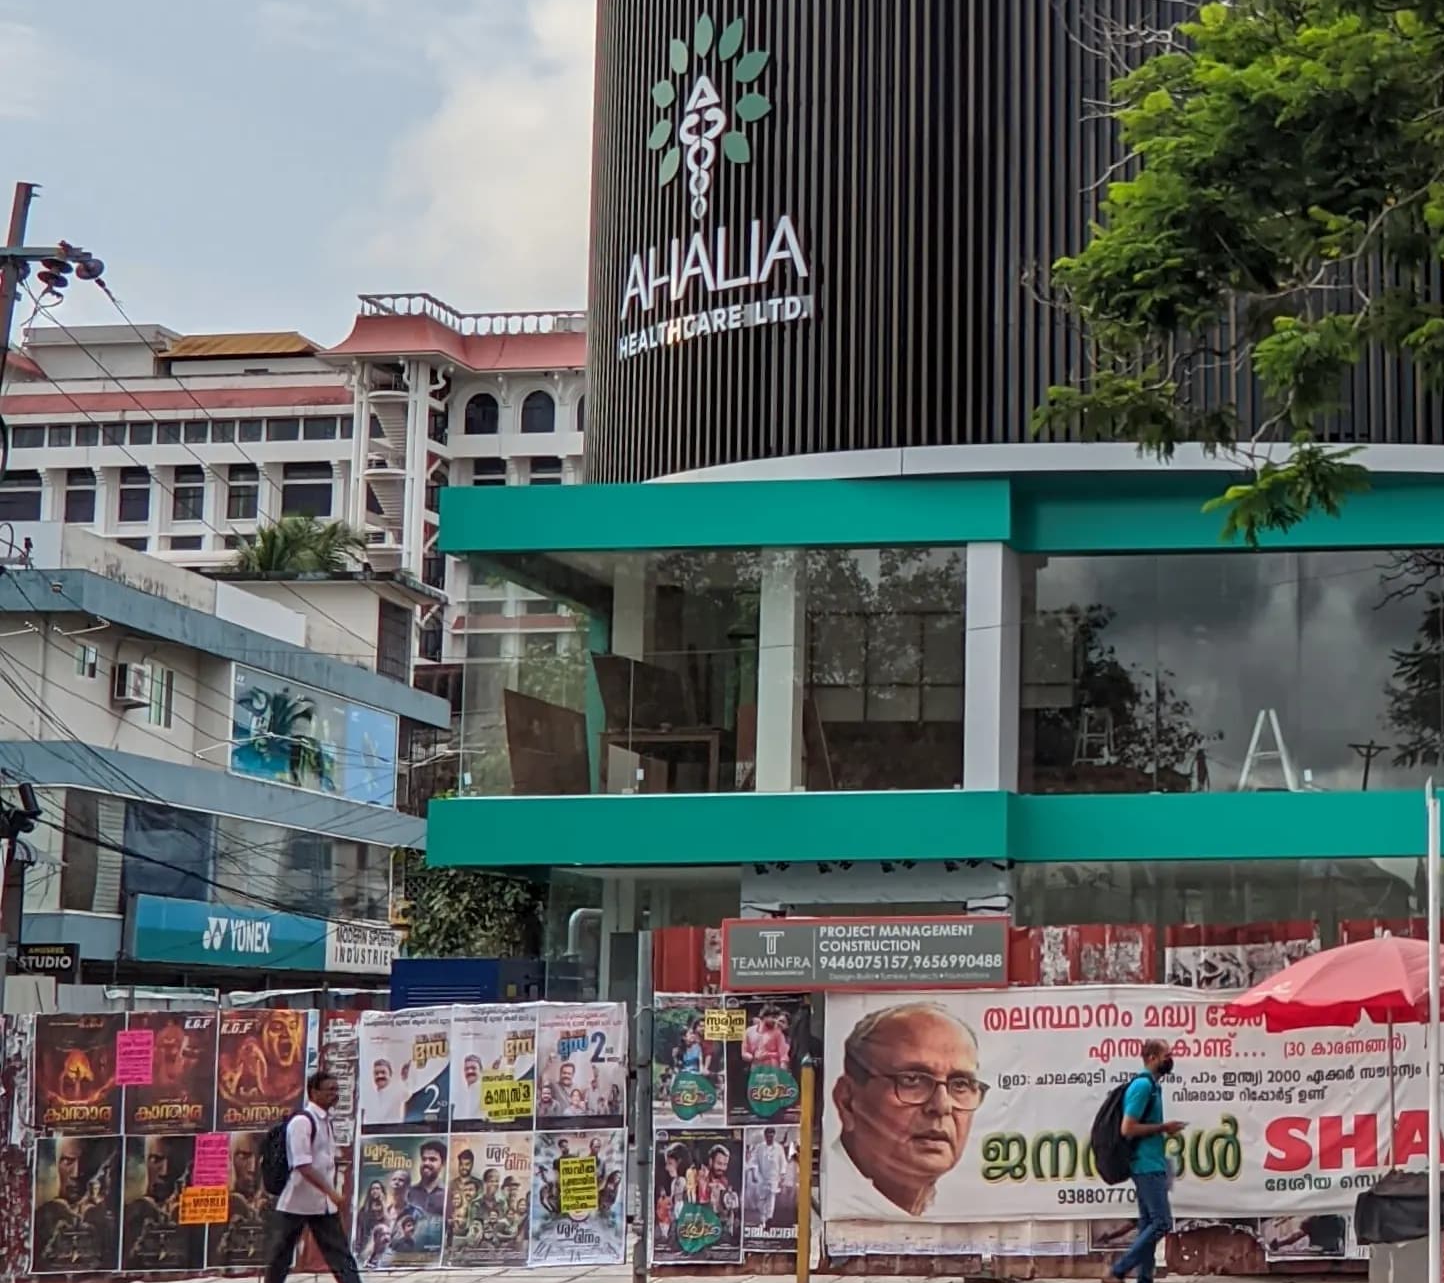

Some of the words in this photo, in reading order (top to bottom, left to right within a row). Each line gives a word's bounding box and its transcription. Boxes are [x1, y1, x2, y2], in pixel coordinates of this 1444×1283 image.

[620, 215, 808, 320] AHALIA
[618, 304, 743, 361] HEALTHCARE
[754, 296, 809, 325] LTD.
[230, 920, 272, 953] YONEX
[336, 925, 367, 945] MODERN
[819, 925, 876, 938] PROJECT
[879, 924, 974, 937] MANAGEMENT
[819, 939, 921, 953] CONSTRUCTION
[19, 955, 72, 970] STUDIO
[334, 945, 394, 967] INDUSTRIES
[731, 956, 812, 970] TEAMINFRA
[819, 953, 1003, 971] 9446075157,9656990488
[221, 1022, 254, 1035] K.G.F
[983, 1003, 1133, 1032] തലസ്ഥാനം
[1143, 1004, 1198, 1035] മദ്ധ്യ
[1034, 1068, 1107, 1092] ചാലക്കുടി
[1190, 1071, 1218, 1085] പാം
[1266, 1070, 1302, 1084] 2000
[1305, 1065, 1356, 1083] ഏക്കർ
[1172, 1087, 1235, 1103] വിശദമായ
[1264, 1173, 1332, 1193] ദേശീയ
[1057, 1187, 1137, 1205] 93880770
